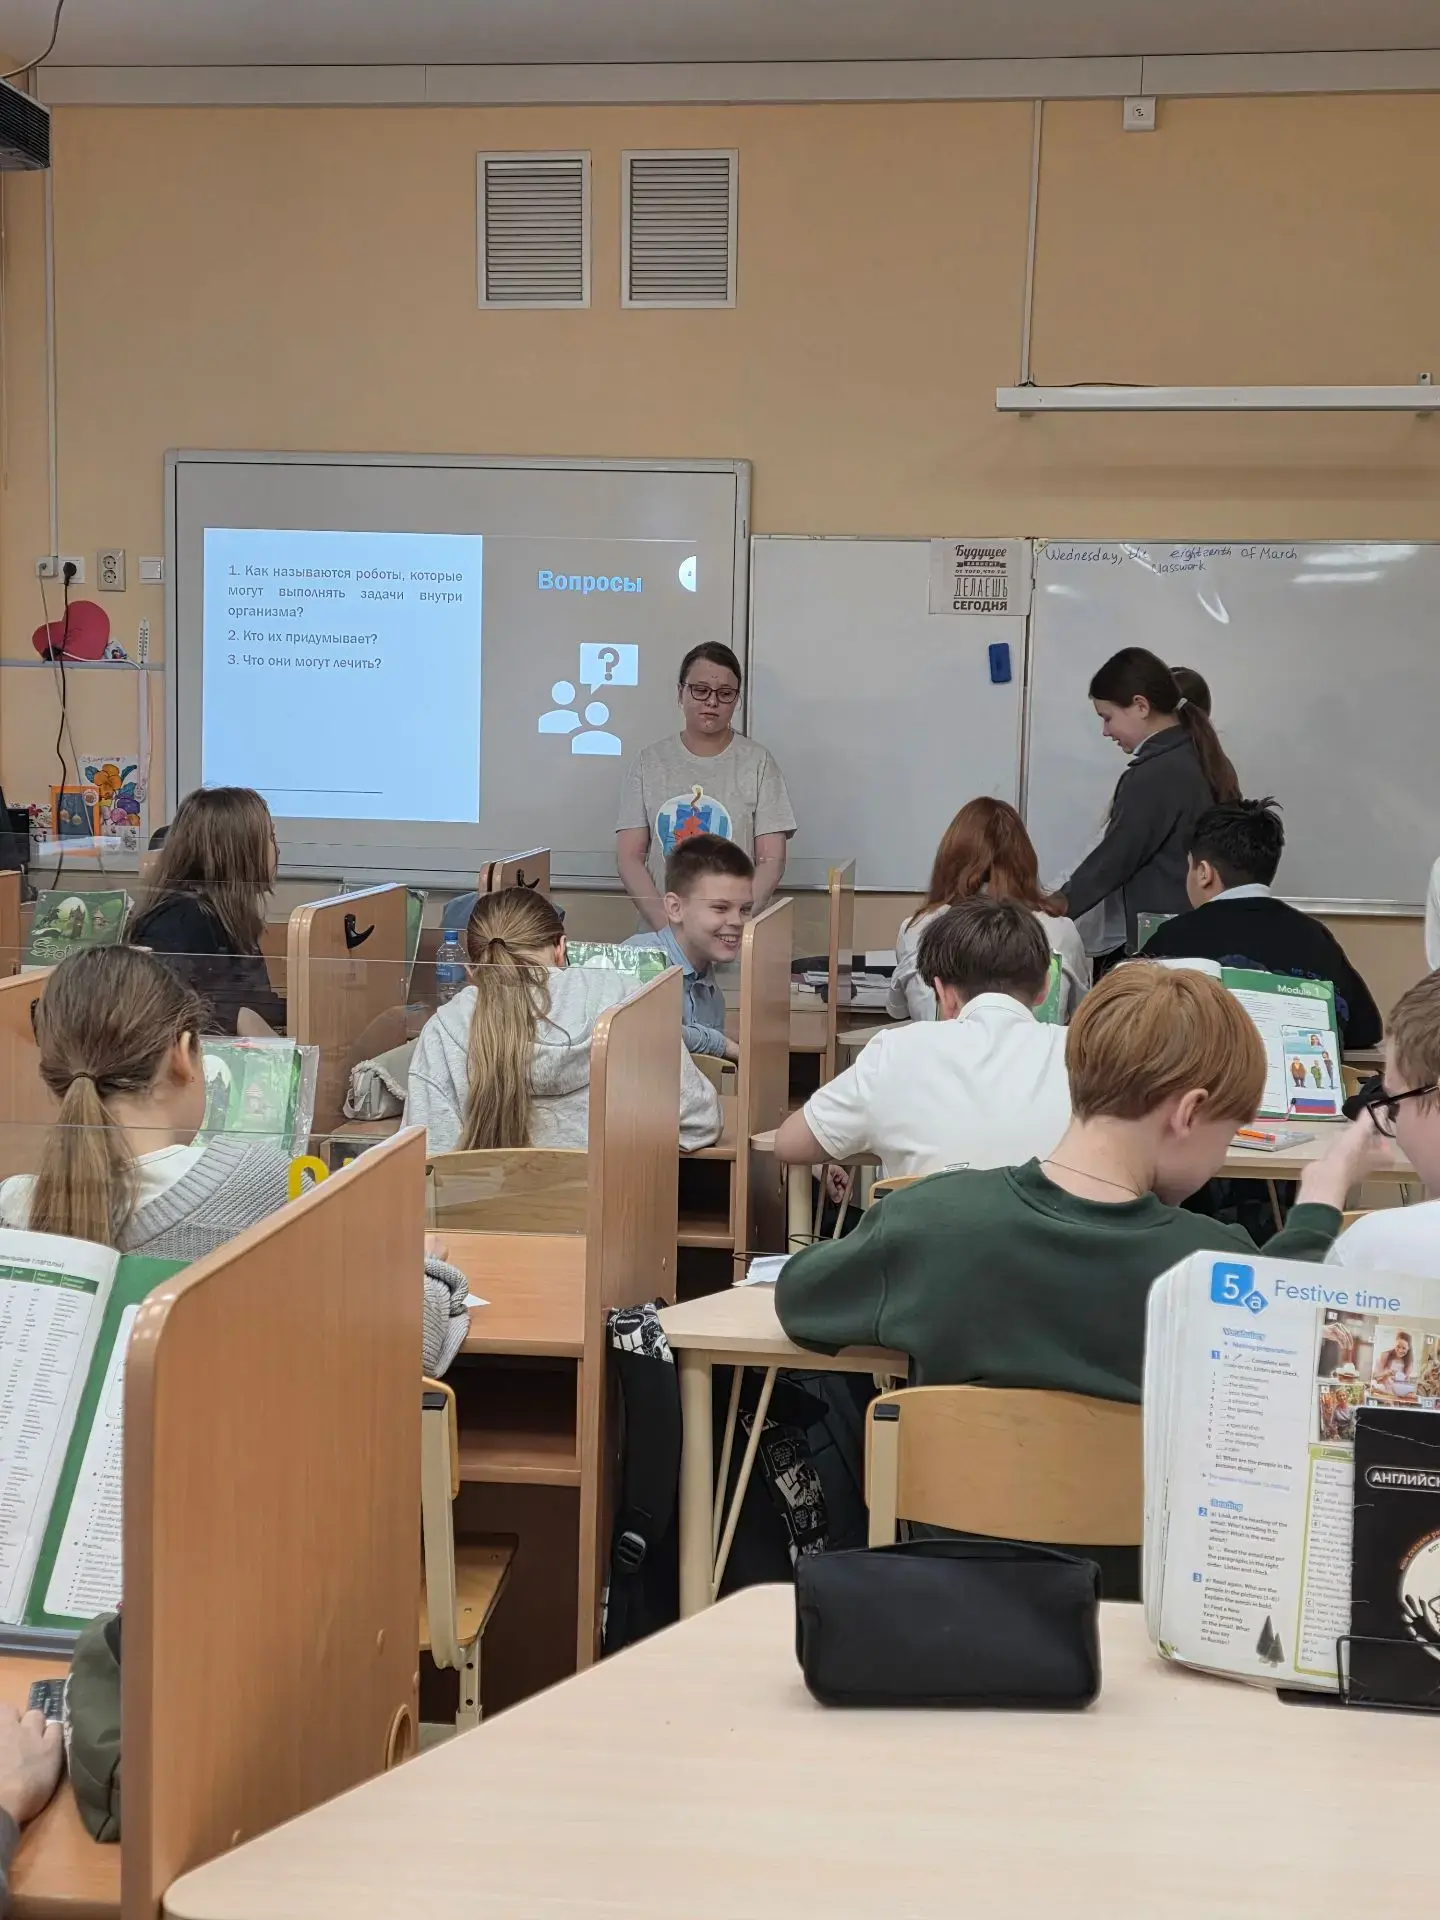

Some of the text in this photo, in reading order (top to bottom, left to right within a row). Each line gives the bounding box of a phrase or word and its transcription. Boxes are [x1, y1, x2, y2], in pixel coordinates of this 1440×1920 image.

[955, 544, 1007, 560] Будущее
[1046, 547, 1123, 565] Wednesday,
[1260, 547, 1298, 560] March
[228, 565, 463, 583] 1. Как называются роботы, которые
[538, 570, 643, 595] Вопросы
[954, 577, 1008, 597] ДЕЛАЕШЬ
[228, 586, 463, 603] могут выполнять задачи внутри
[228, 606, 304, 618] организма?
[953, 600, 1008, 612] СЕГОДНЯ
[228, 629, 378, 645] 2. Кто их придумывает?
[227, 654, 382, 670] 3. Что они могут лечить?
[1277, 984, 1311, 996] Module
[1223, 1274, 1401, 1312] 5 a Festive time
